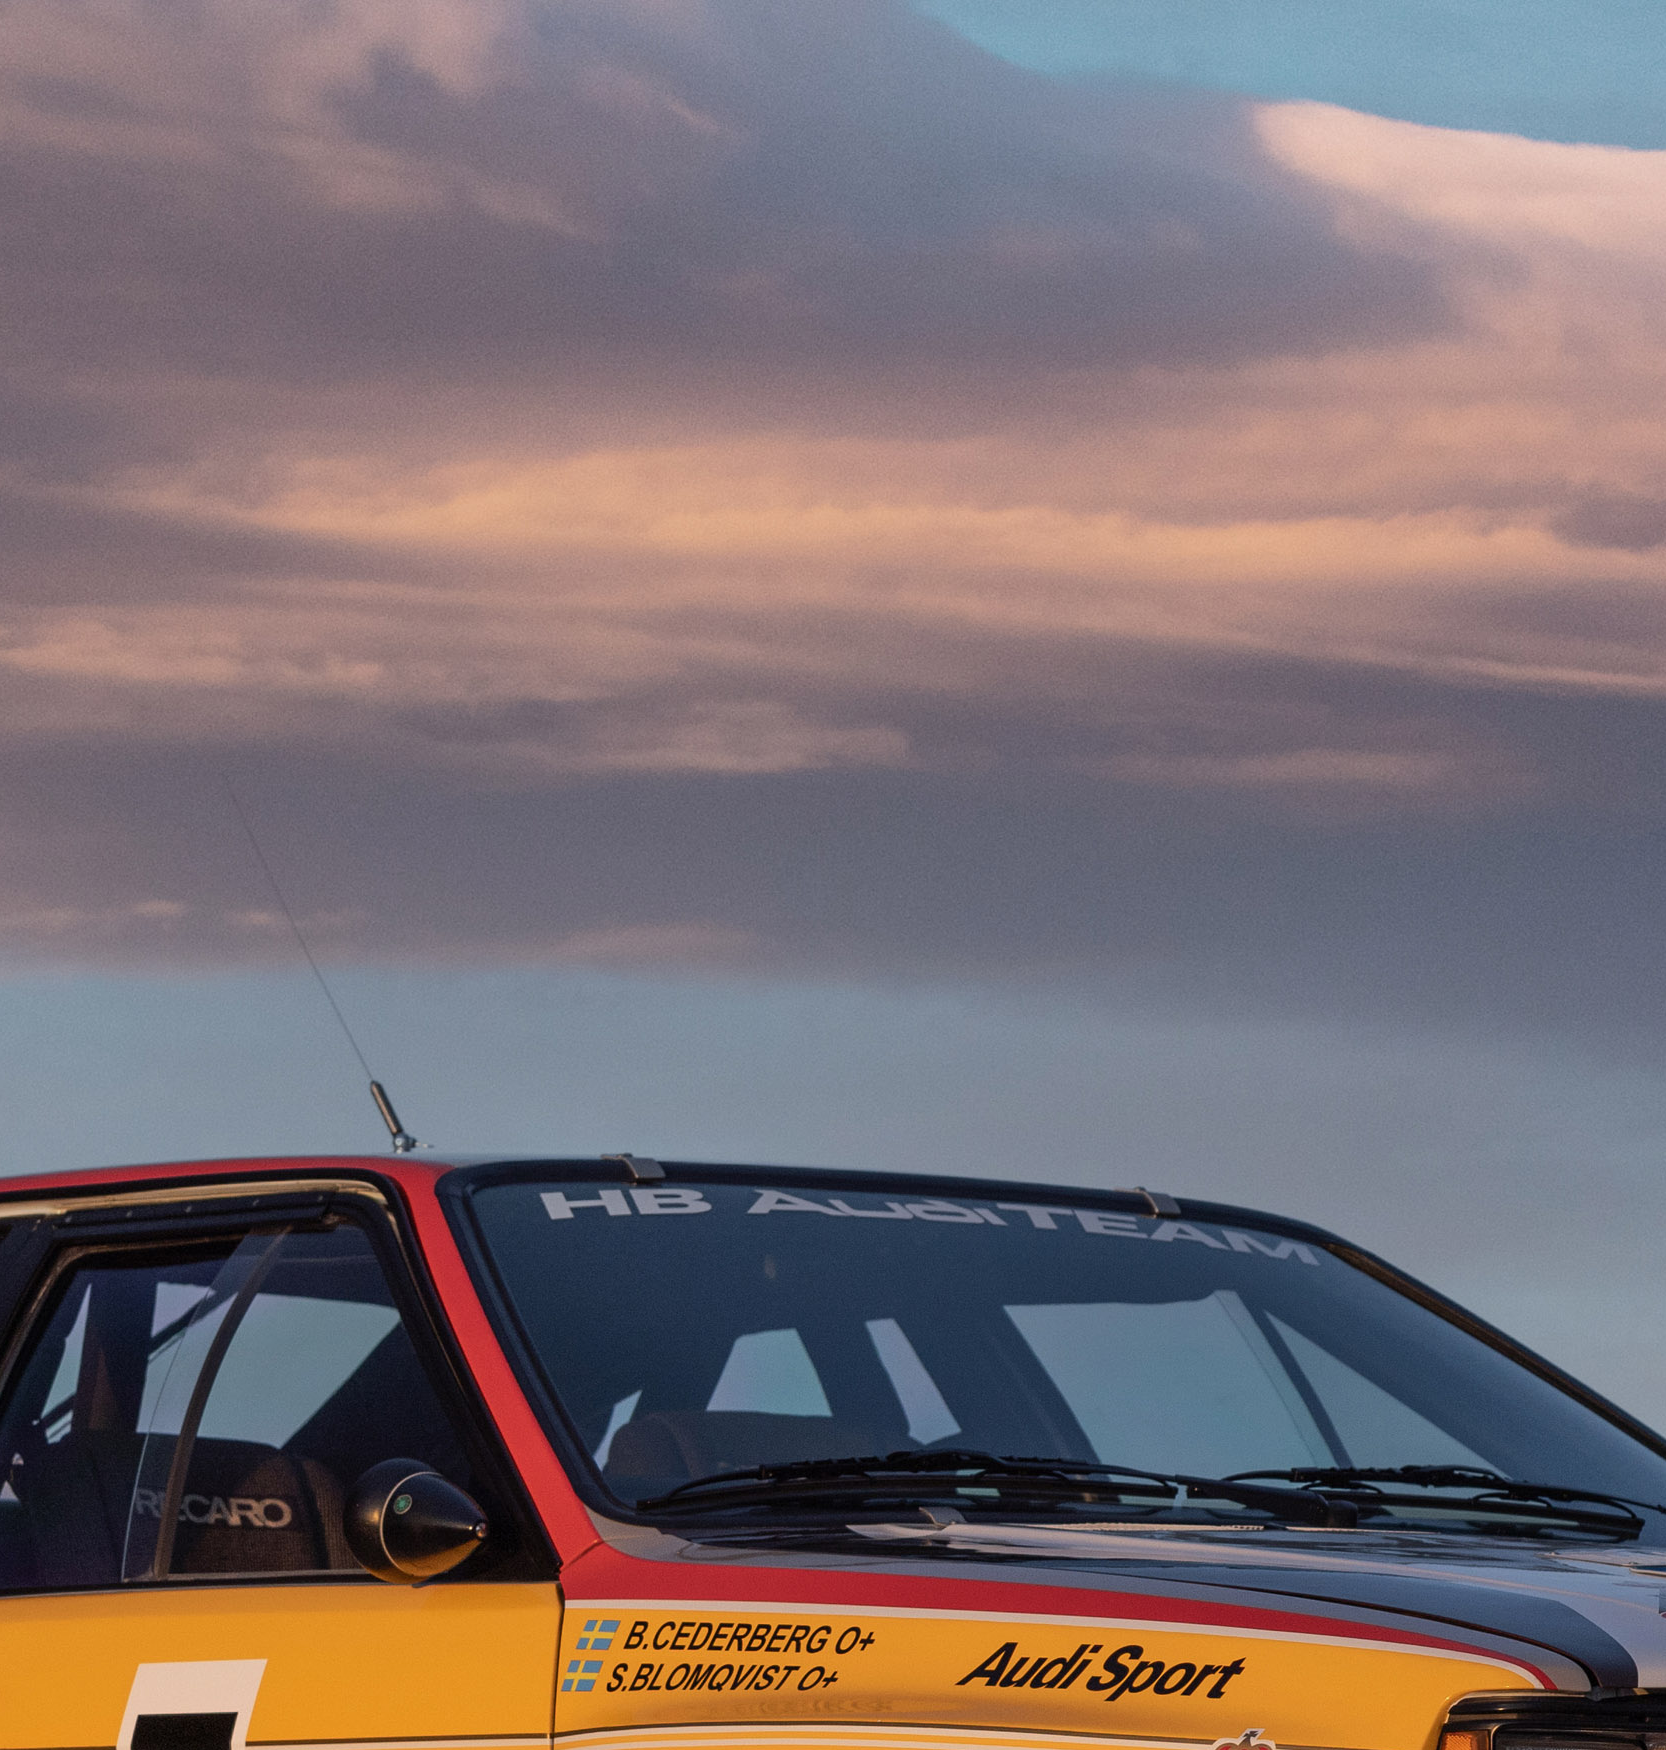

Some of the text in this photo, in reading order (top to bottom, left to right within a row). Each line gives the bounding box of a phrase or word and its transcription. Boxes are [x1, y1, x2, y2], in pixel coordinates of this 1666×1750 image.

[540, 1188, 712, 1220] HB
[623, 1620, 833, 1654] B.CEDERBERG
[606, 1662, 800, 1693] S.BLOMQVIST
[956, 1641, 1247, 1703] Audi Sport
